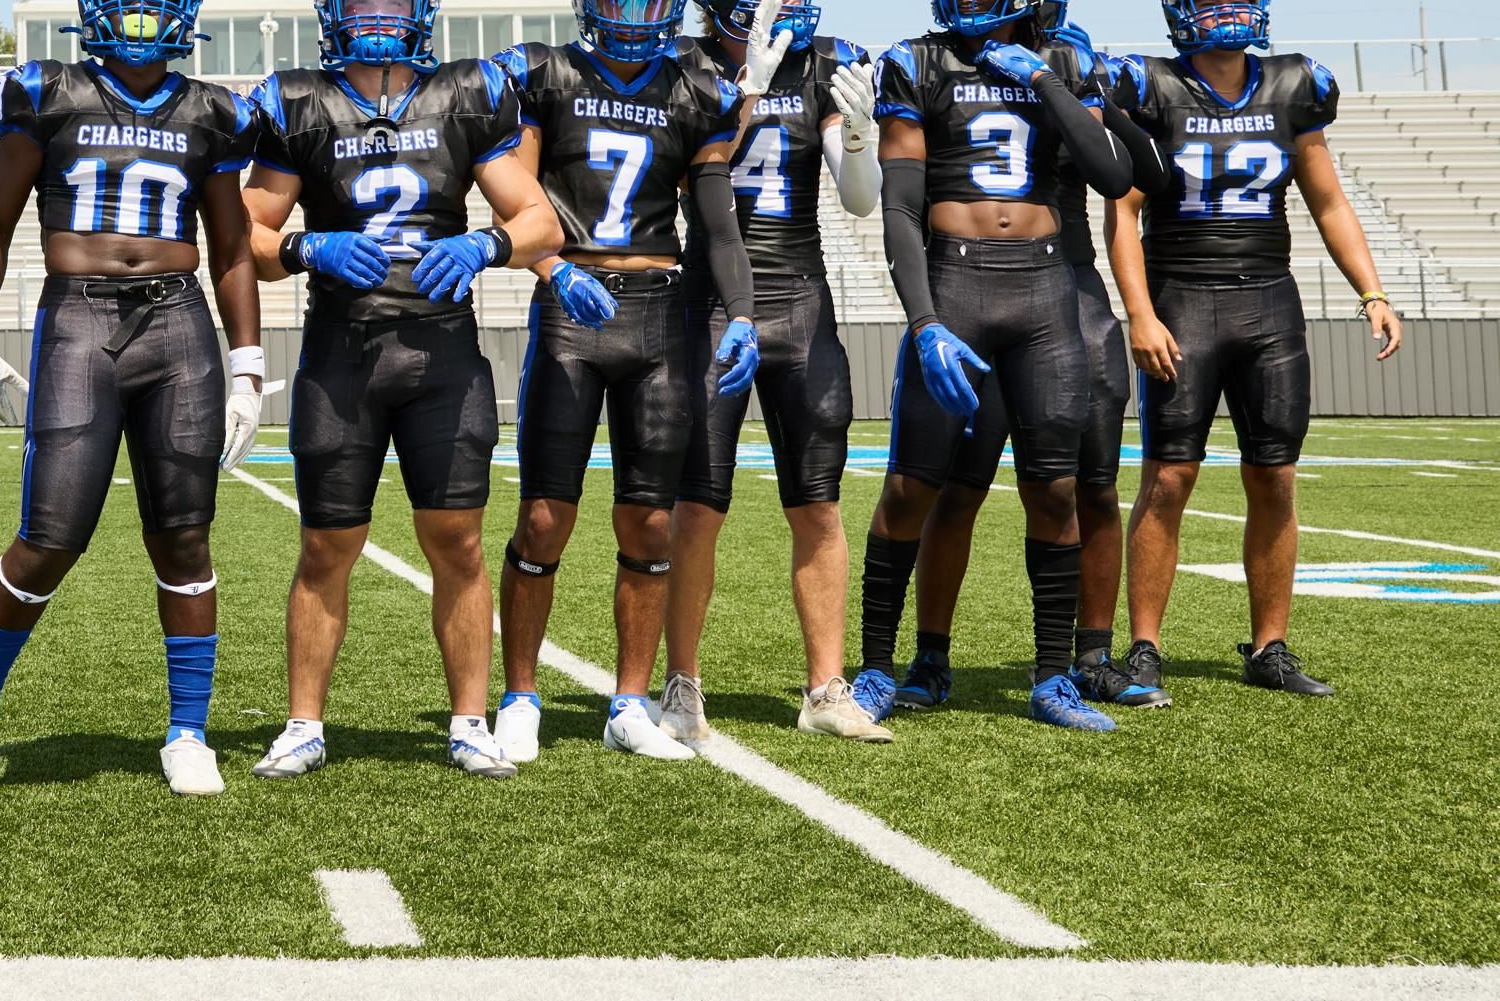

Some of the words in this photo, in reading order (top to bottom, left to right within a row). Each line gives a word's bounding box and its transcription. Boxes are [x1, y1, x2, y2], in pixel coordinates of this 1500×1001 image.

[573, 97, 668, 127] CHARGERS
[752, 95, 805, 116] GERS
[953, 84, 1043, 104] CHARGER
[1185, 114, 1276, 135] CHARGERS
[76, 124, 188, 153] CHARGERS
[729, 123, 792, 218] 4
[966, 110, 1037, 198] 3
[61, 157, 192, 240] 10
[351, 163, 429, 260] 2
[586, 127, 654, 247] 7
[1173, 139, 1289, 219] 12
